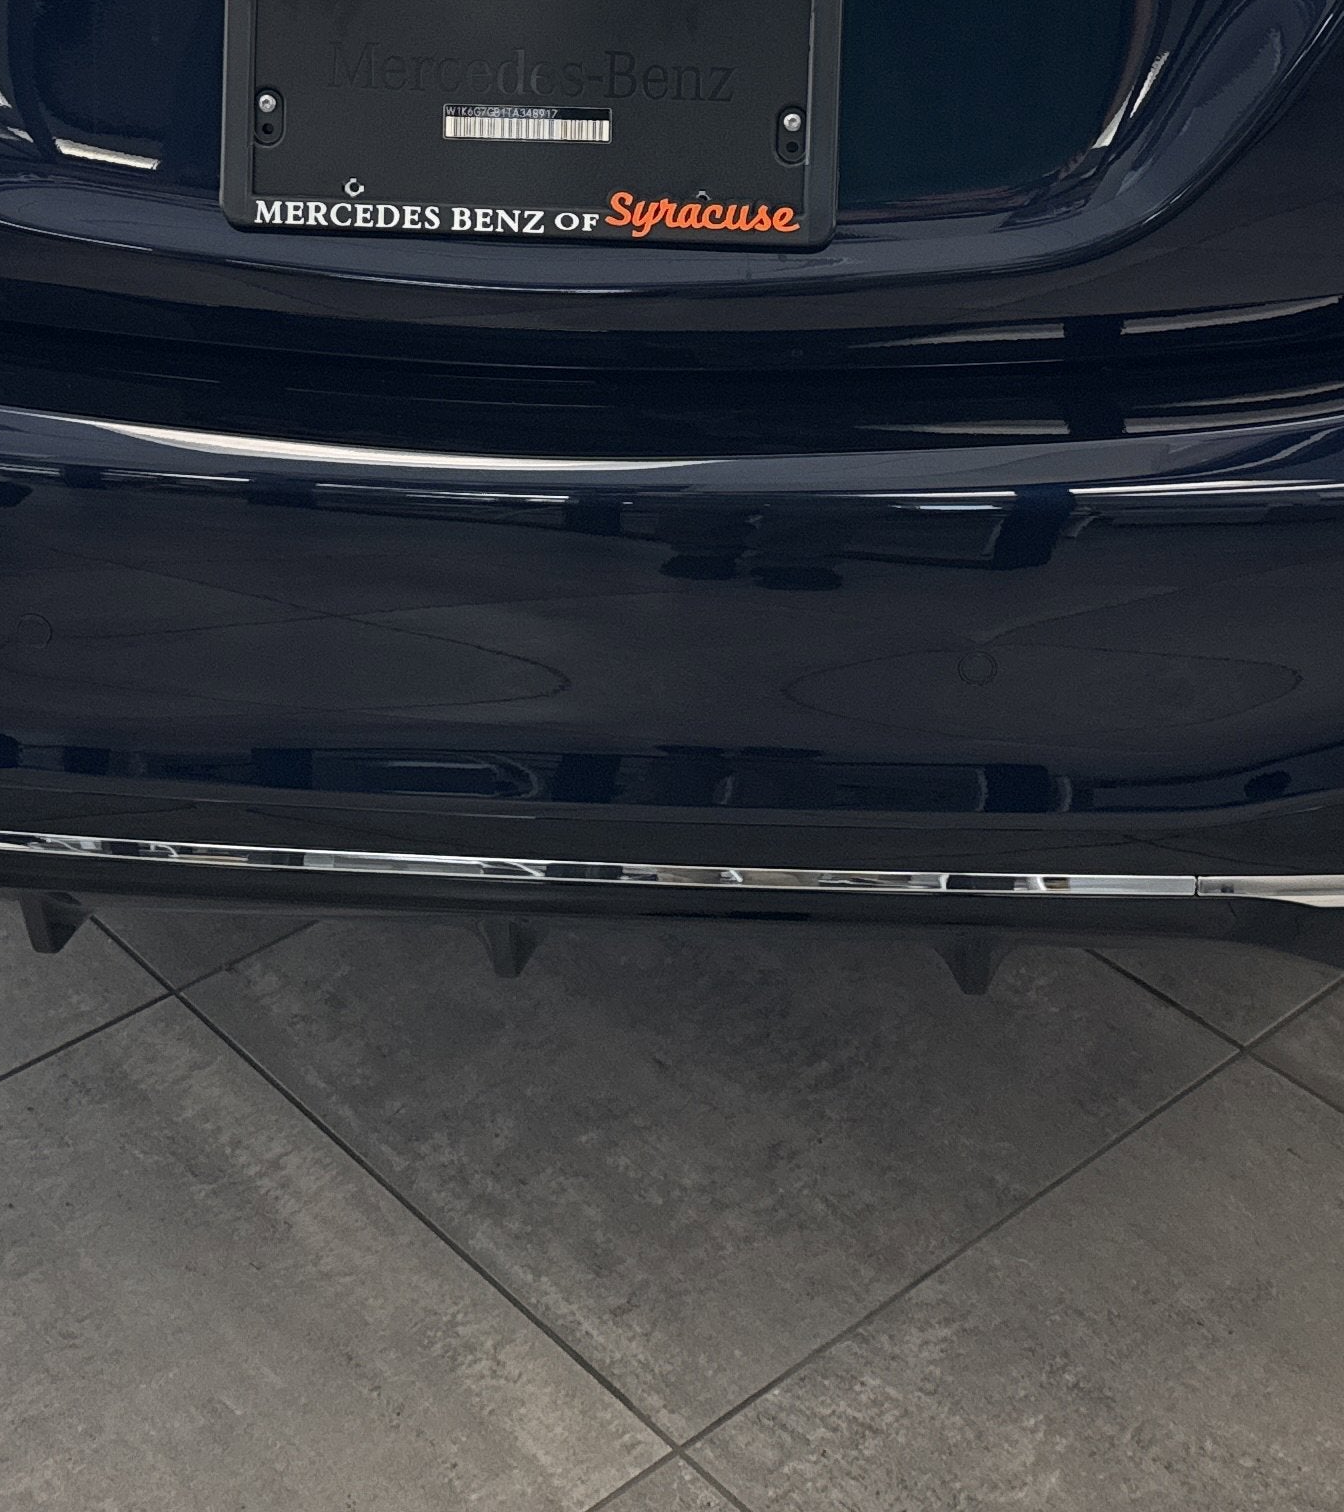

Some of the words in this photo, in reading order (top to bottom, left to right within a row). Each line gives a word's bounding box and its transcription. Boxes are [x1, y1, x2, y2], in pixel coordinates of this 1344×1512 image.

[327, 40, 737, 102] Mercedes-Benz
[254, 199, 440, 229] MERCEDES
[451, 207, 544, 234] BENZ
[554, 213, 599, 231] OF
[605, 191, 800, 237] Syracuse
